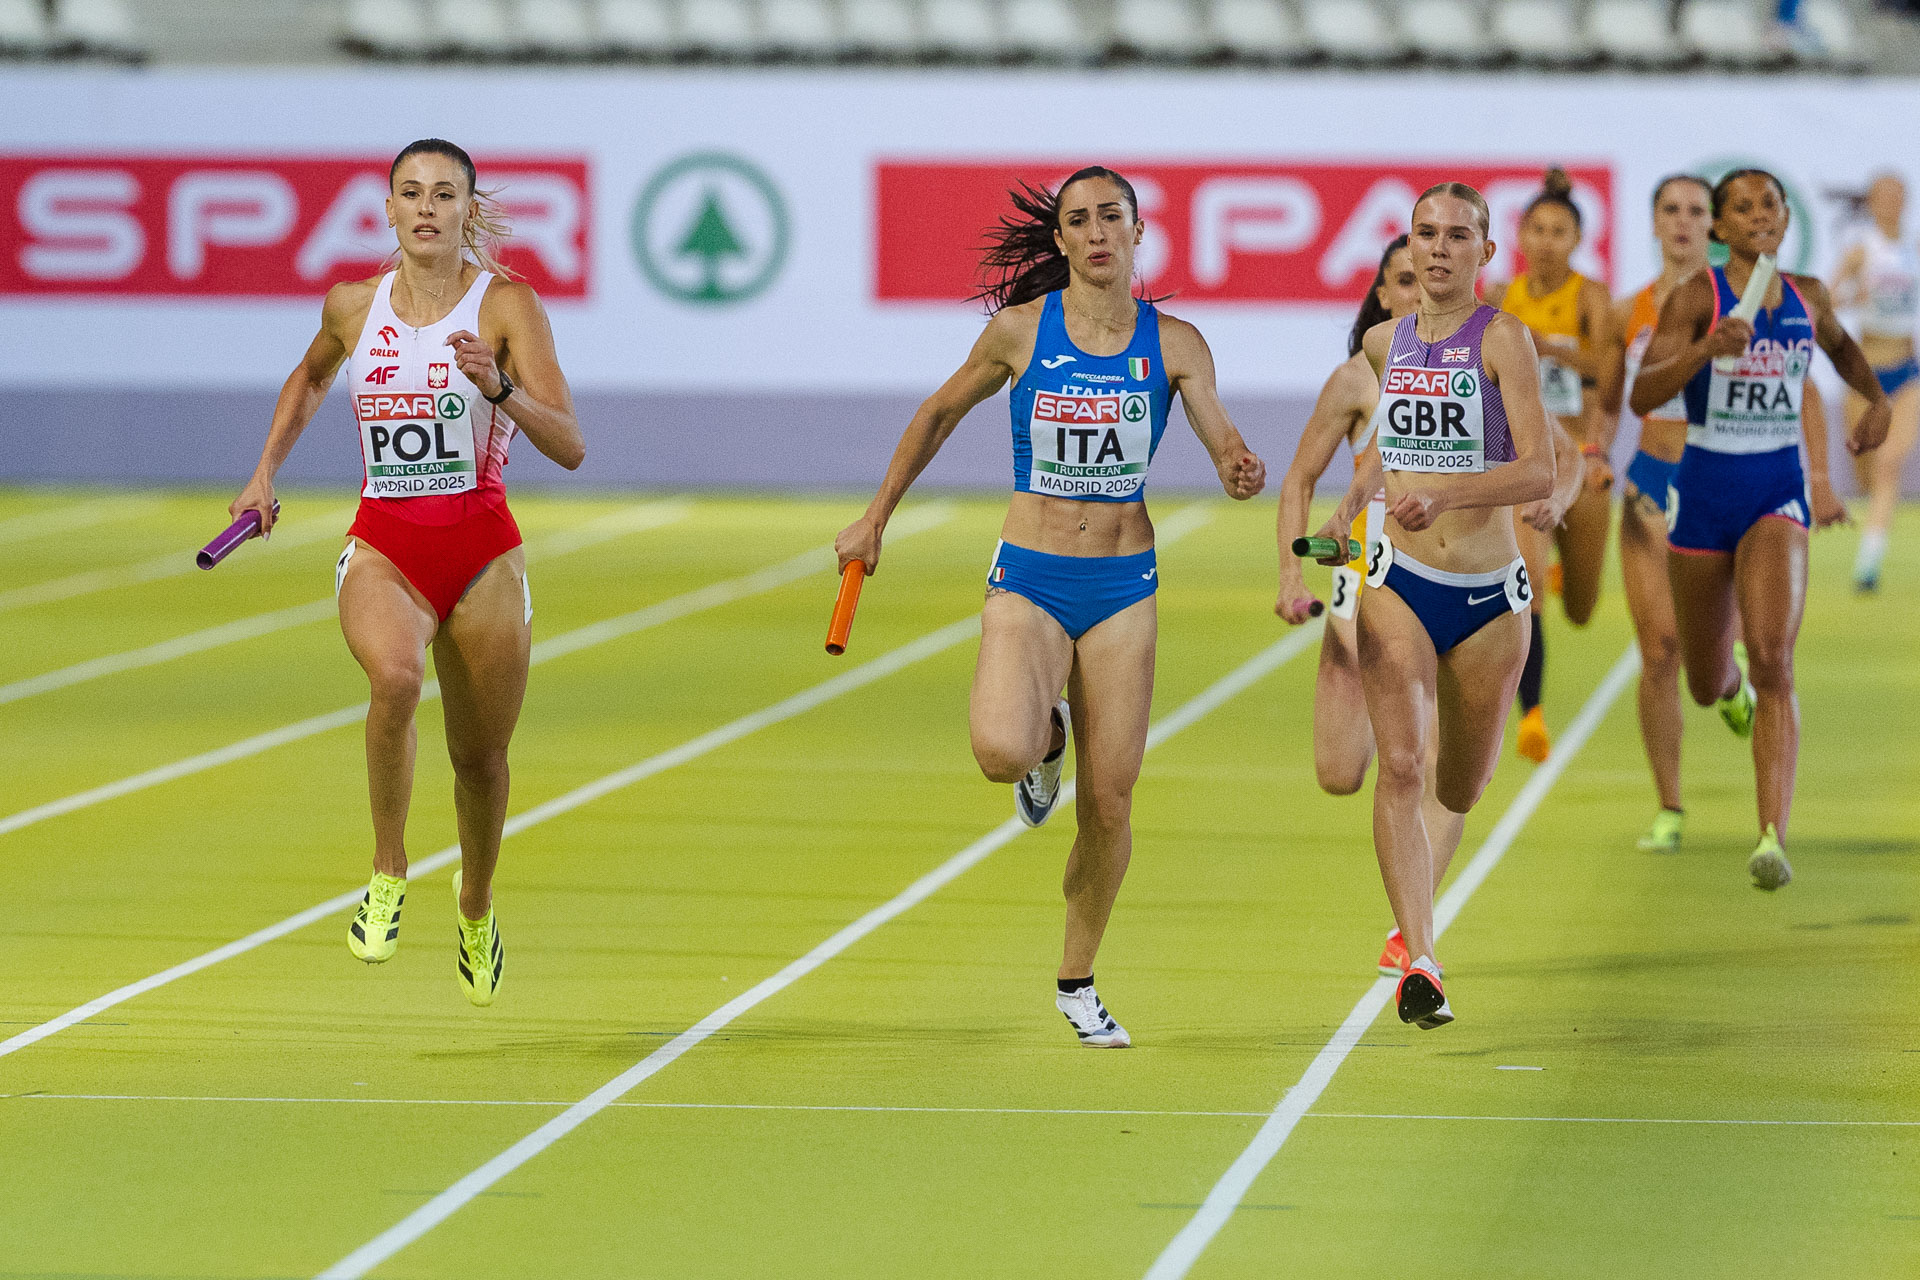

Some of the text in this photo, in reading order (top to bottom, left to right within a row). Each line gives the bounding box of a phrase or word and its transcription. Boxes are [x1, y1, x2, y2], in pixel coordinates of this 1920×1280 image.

[15, 169, 585, 283] SPAR
[369, 348, 399, 358] ORLEN
[365, 365, 400, 385] 4F
[1071, 372, 1125, 382] FRECCIAROSSA
[1387, 371, 1447, 393] SPAR
[1726, 380, 1792, 411] FRA
[360, 396, 434, 418] SPAR
[1037, 397, 1118, 421] SPAR
[1388, 398, 1472, 438] GBR
[369, 422, 460, 463] POL
[1056, 427, 1125, 464] ITA
[1396, 438, 1400, 447] I
[1400, 439, 1418, 449] RUN
[1054, 464, 1059, 473] I
[1060, 466, 1083, 476] RUN
[1382, 451, 1474, 468] MADRID 2025
[428, 476, 466, 490] 2025
[1040, 475, 1138, 493] MADRID 2025
[1333, 575, 1346, 607] 3
[1515, 564, 1529, 602] 8
